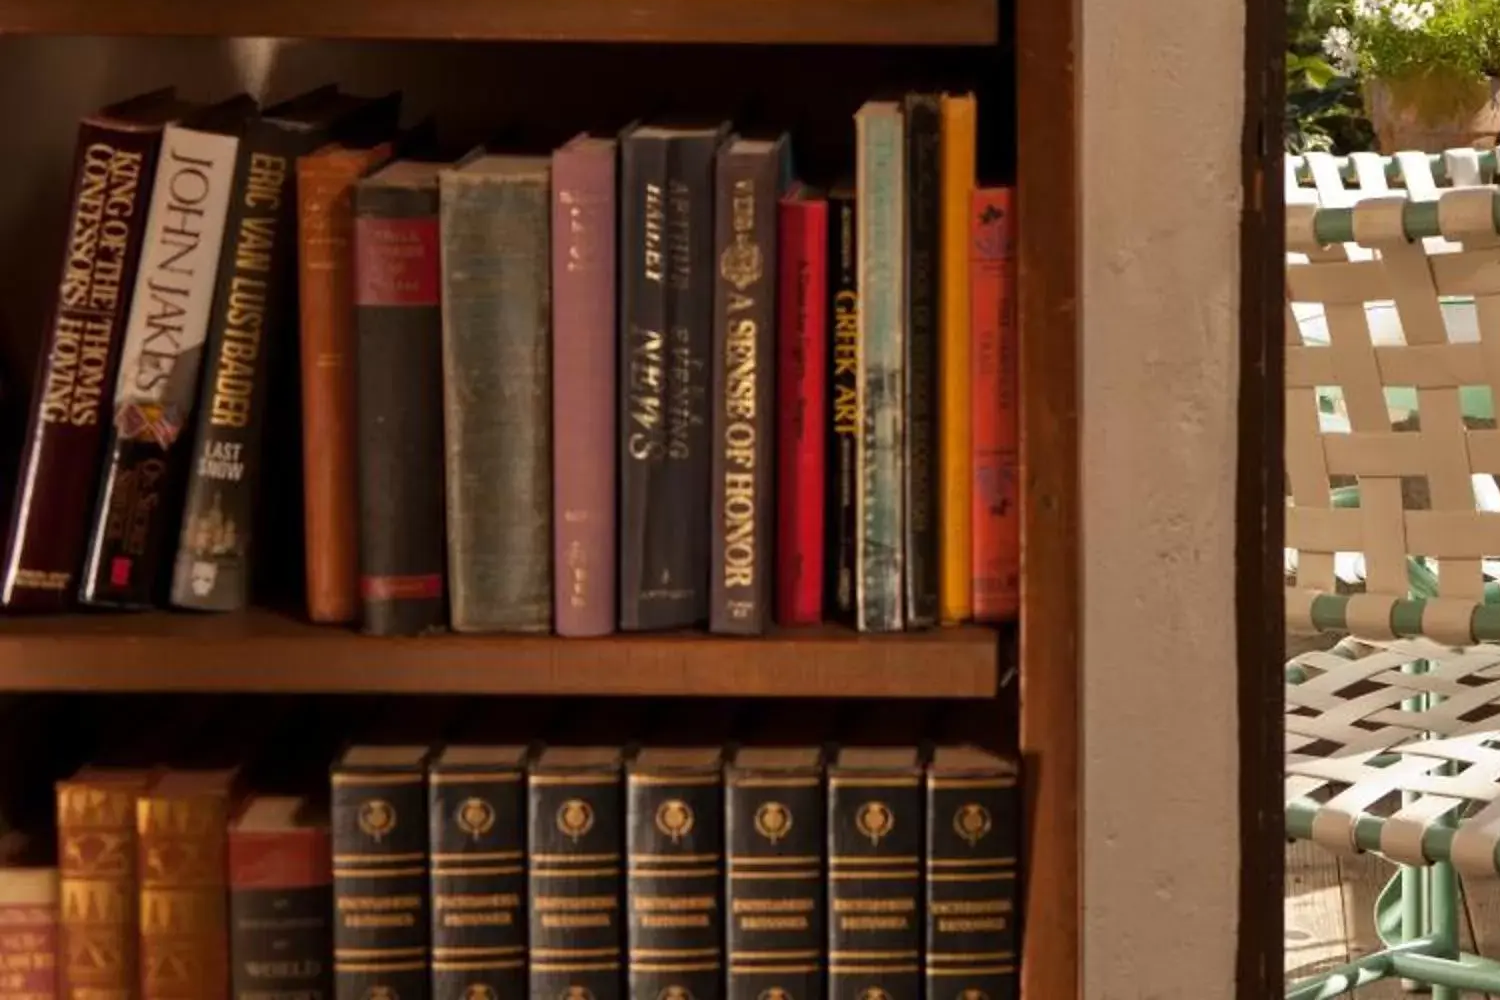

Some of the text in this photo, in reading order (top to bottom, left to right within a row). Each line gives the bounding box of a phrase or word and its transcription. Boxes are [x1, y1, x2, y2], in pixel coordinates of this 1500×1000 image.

[62, 143, 116, 308] CONFESSORS
[91, 149, 144, 311] KING OF THE
[136, 150, 214, 393] JOHN JAKES
[644, 182, 664, 284] HAILEY
[210, 152, 287, 430] ERIC VAN LUSTBADER
[834, 289, 861, 377] GREEK
[44, 315, 84, 425] HOVING
[71, 317, 115, 427] THOMAS
[629, 325, 666, 461] NEWS
[834, 383, 862, 438] ART
[197, 457, 245, 482] SNOW
[204, 440, 245, 462] LAST
[724, 291, 758, 589] A SENSE OF HONOR
